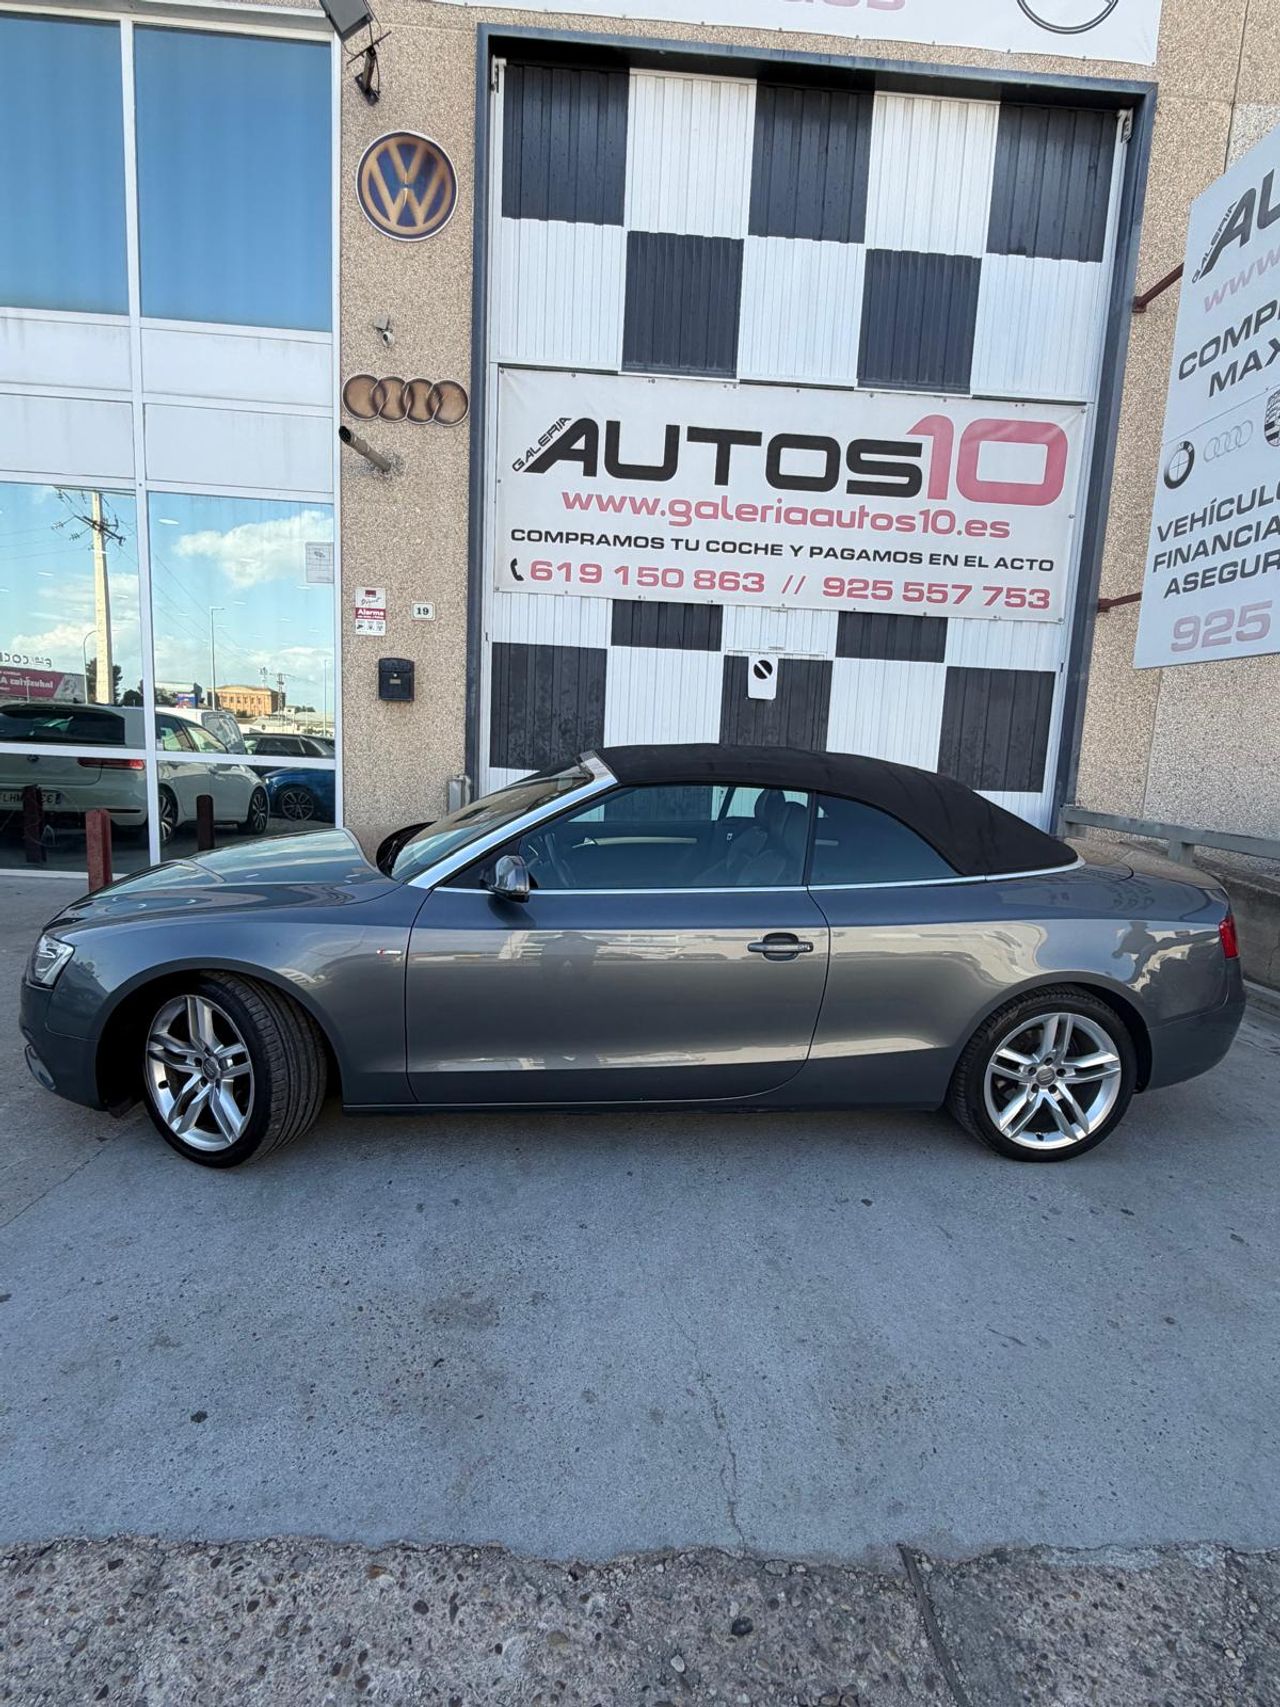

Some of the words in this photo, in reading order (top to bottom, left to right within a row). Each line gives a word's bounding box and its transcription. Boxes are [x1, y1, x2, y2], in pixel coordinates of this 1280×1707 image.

[1178, 299, 1280, 381] COMP
[511, 416, 573, 473] GALERIA
[522, 414, 1069, 507] AUTOS10
[561, 491, 1011, 539] www.galeriaautos10.es
[1157, 481, 1280, 542] VEHÍCUL
[510, 528, 665, 550] COMPRAMOS
[670, 538, 700, 552] TU
[705, 540, 784, 556] COCHE
[789, 544, 804, 558] Y
[809, 546, 924, 565] PAGAMOS
[928, 553, 959, 567] EN
[963, 555, 989, 569] EL
[993, 557, 1055, 572] ACTO
[416, 607, 429, 616] 19
[529, 560, 602, 584] 619
[614, 565, 685, 588] 150
[693, 569, 766, 593] 863
[822, 576, 893, 601] 925
[902, 580, 973, 605] 557
[981, 585, 1051, 610] 753
[1170, 600, 1273, 653] 925
